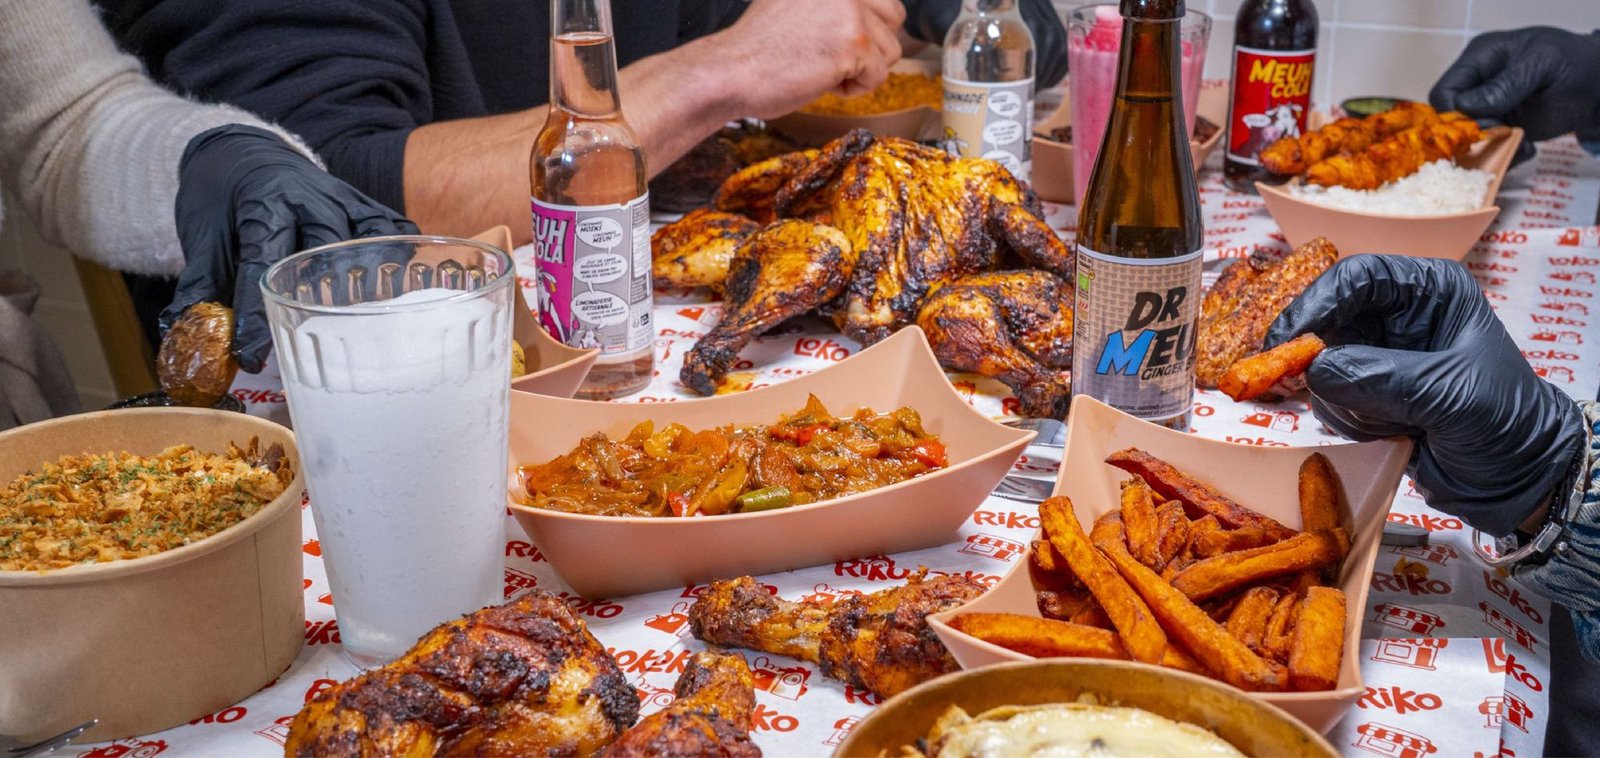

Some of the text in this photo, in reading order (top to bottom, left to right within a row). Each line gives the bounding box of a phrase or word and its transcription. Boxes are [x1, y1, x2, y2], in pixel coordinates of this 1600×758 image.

[1249, 59, 1313, 84] MEUH
[1125, 286, 1187, 331] DR
[1141, 363, 1182, 381] GINGER
